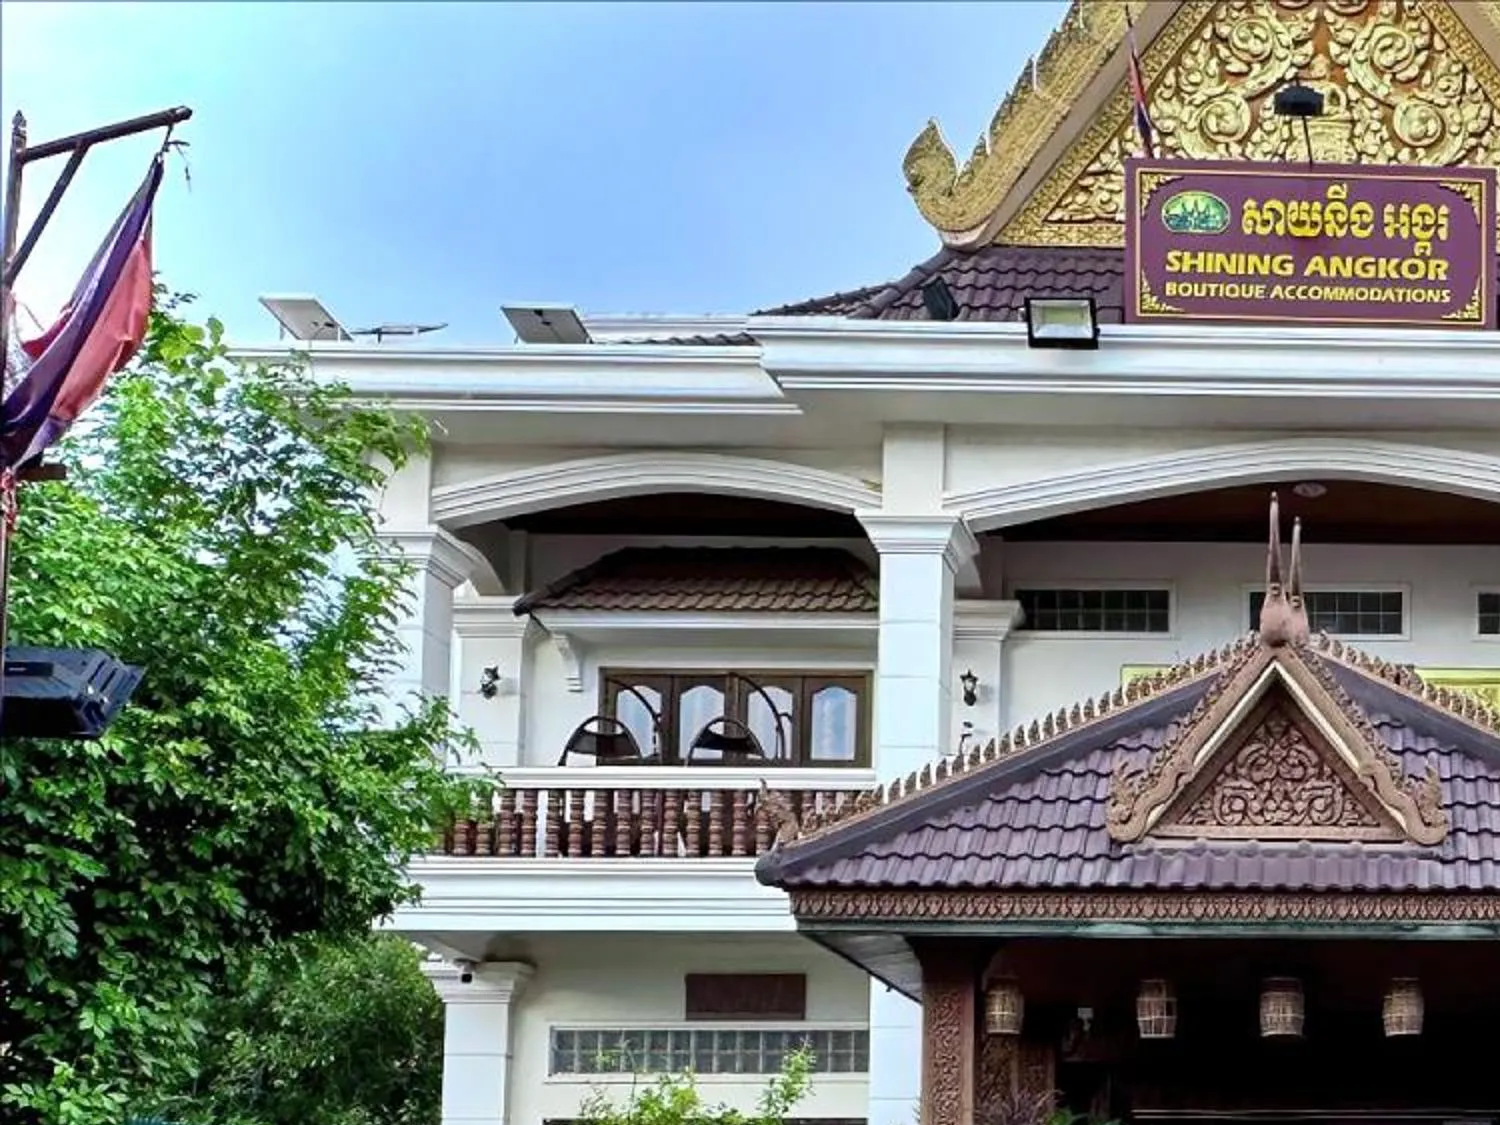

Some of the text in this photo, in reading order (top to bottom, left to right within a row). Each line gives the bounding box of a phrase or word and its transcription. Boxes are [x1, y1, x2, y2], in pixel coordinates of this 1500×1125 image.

[1383, 203, 1449, 257] អង្គរ
[1165, 250, 1449, 280] SHINING ANGKOR
[1165, 281, 1451, 303] BOUTIQUE ACCOMMODATIONS
